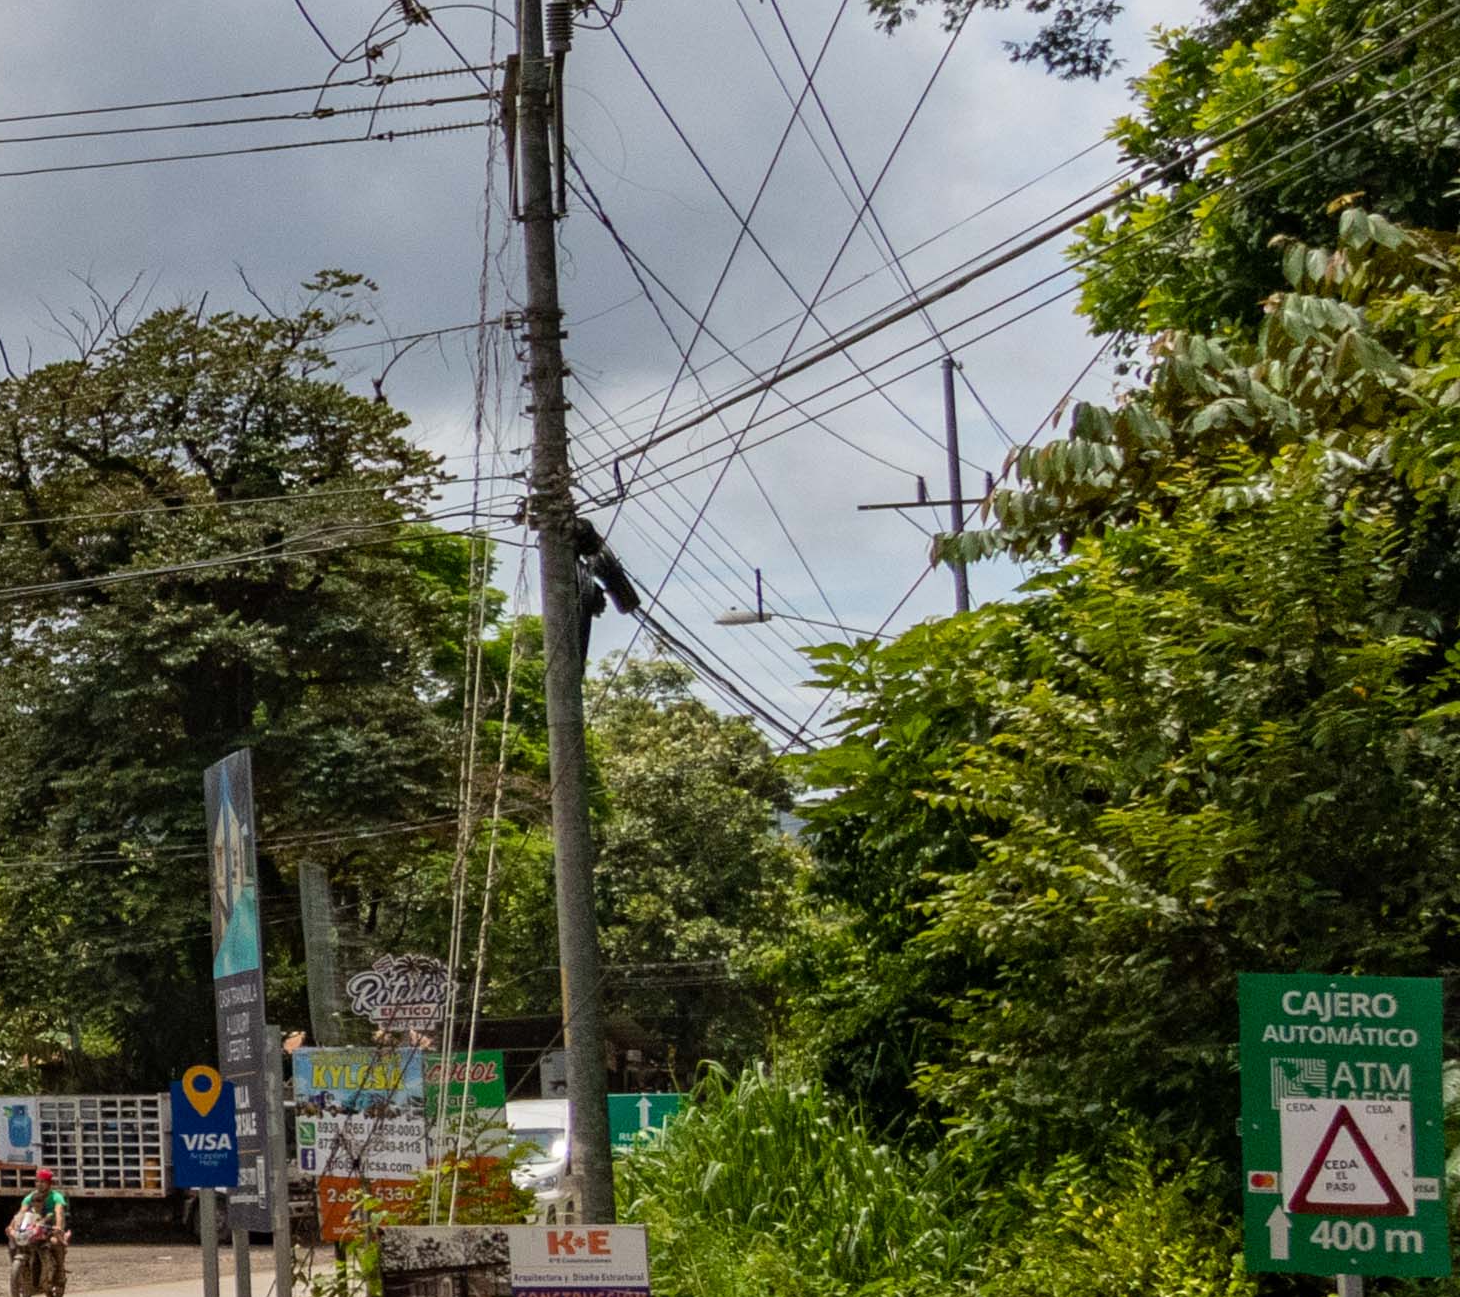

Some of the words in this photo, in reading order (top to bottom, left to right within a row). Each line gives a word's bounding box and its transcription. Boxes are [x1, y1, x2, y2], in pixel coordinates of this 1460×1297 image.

[403, 1007, 431, 1016] TICO
[1281, 990, 1398, 1023] CAJERO
[1261, 1022, 1419, 1048] AUTOMÁTICO
[311, 1064, 404, 1090] KYLCSA
[1331, 1061, 1411, 1092] ATM
[1286, 1103, 1316, 1113] CEDA
[1365, 1105, 1393, 1115] CEDA
[179, 1133, 232, 1151] VISA
[190, 1151, 228, 1161] Accepted
[199, 1158, 219, 1167] Here
[1324, 1159, 1359, 1170] CEDA
[1336, 1171, 1348, 1180] EL
[1326, 1182, 1356, 1192] PASO
[1310, 1220, 1377, 1251] 400
[1384, 1229, 1424, 1254] m
[514, 1273, 562, 1283] Arquitectura
[572, 1272, 599, 1282] Diseño
[601, 1272, 644, 1282] Estructural
